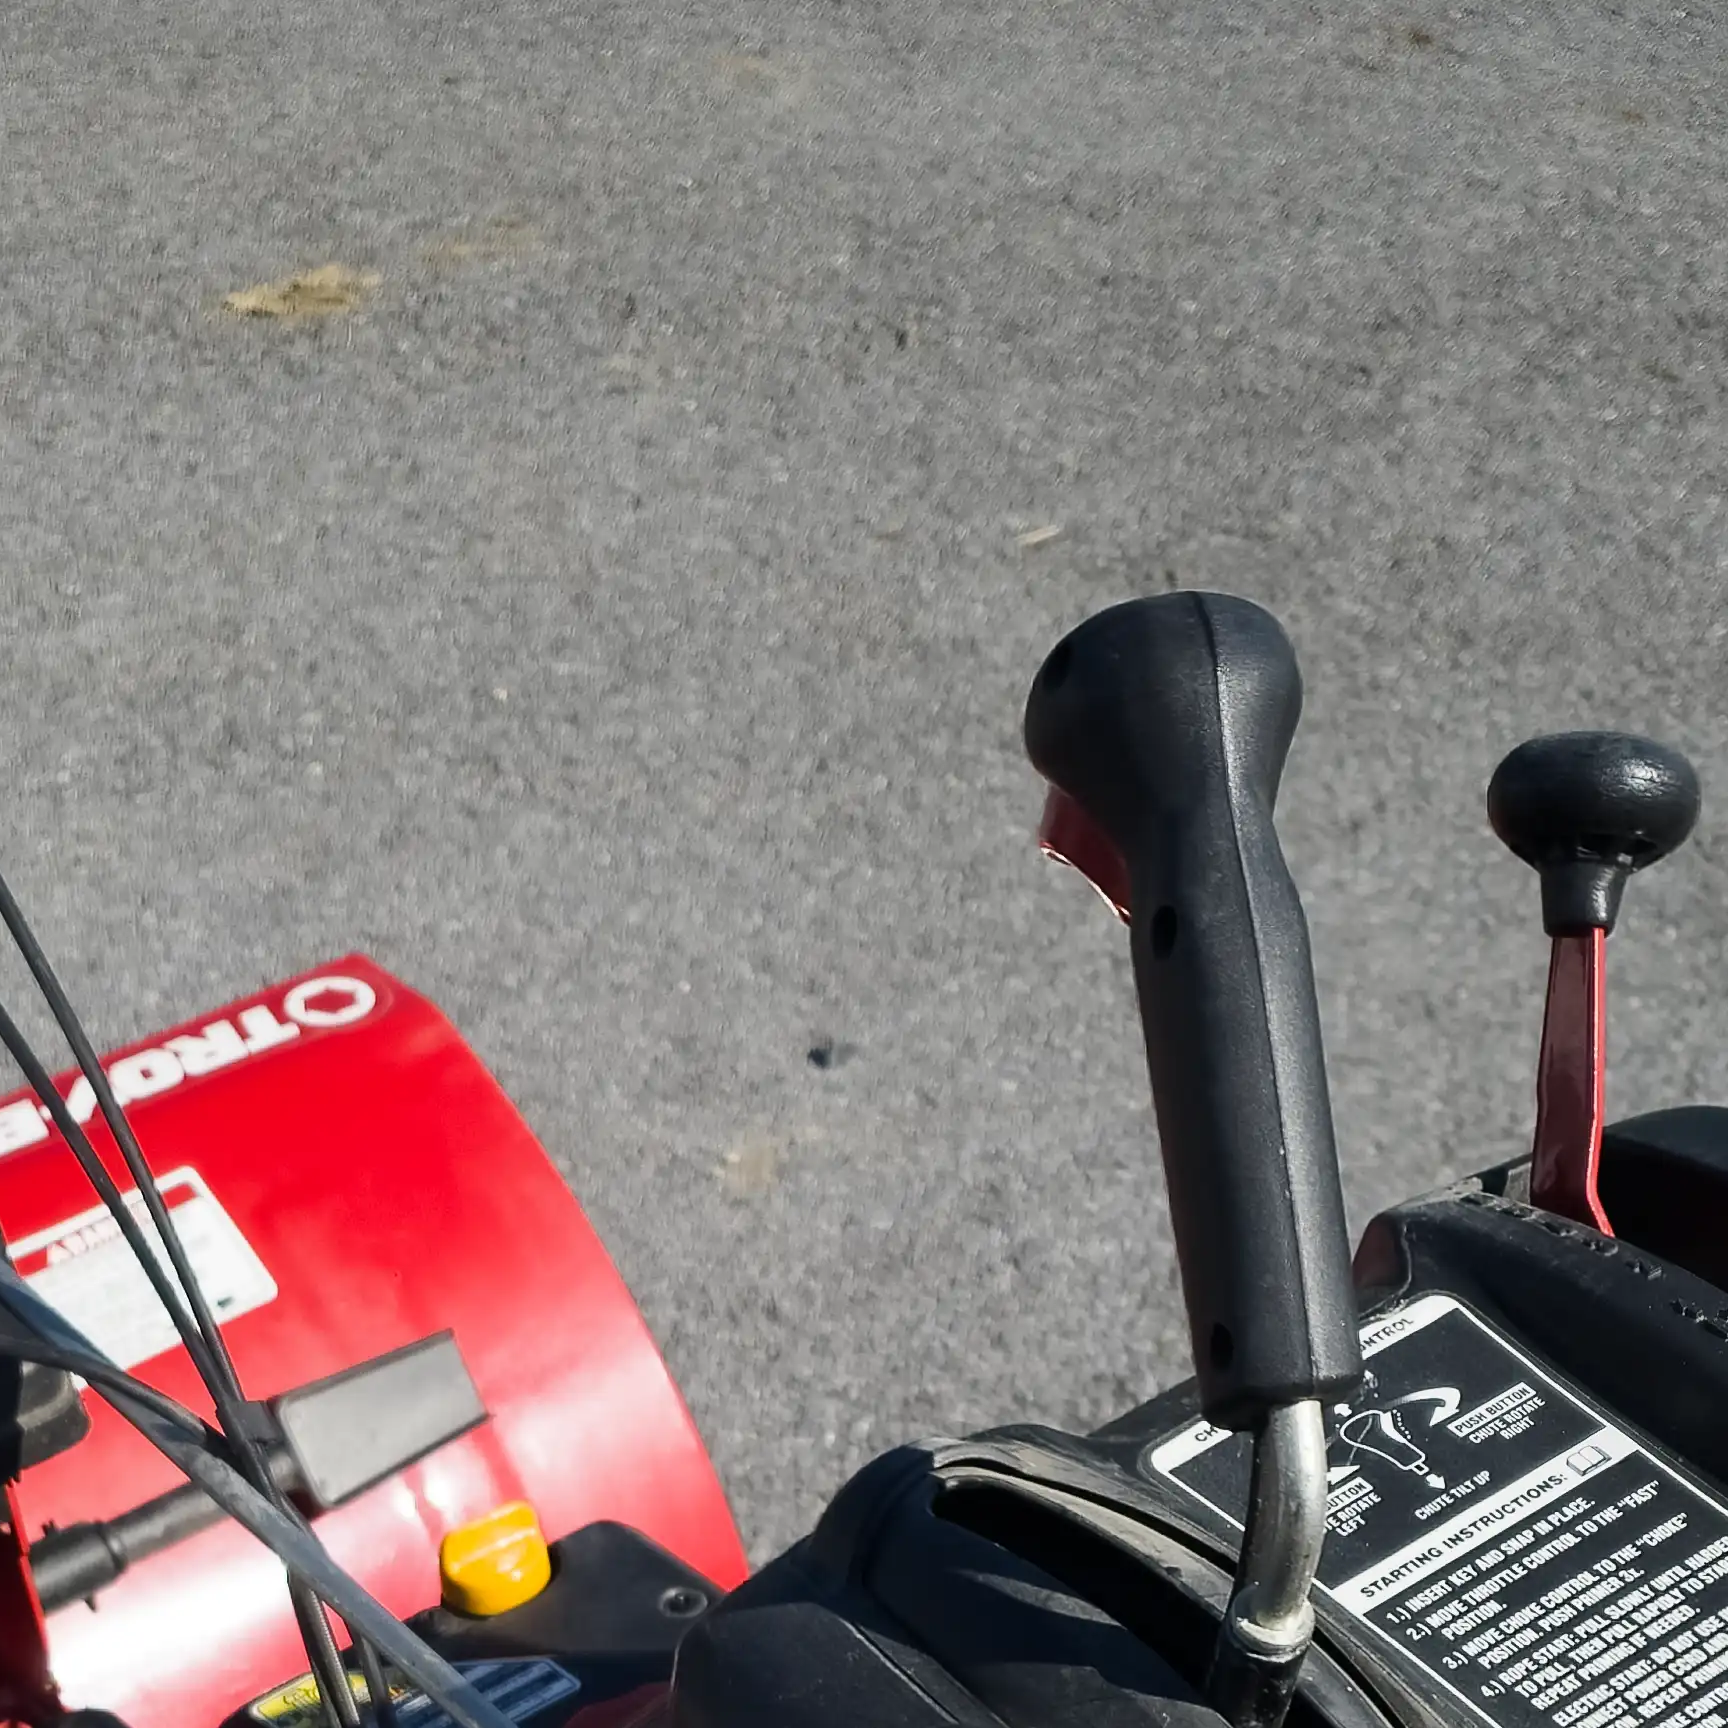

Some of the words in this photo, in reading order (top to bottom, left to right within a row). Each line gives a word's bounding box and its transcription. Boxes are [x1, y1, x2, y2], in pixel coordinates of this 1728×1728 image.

[1454, 1412, 1487, 1432] PUSH
[1485, 1387, 1530, 1415] BUTTON
[1468, 1418, 1506, 1443] CHUTE
[1502, 1396, 1545, 1423] ROTATE
[1499, 1415, 1534, 1439] RIGHT
[1319, 1481, 1368, 1511] UTTON
[1336, 1491, 1381, 1521] ROTATE
[1414, 1493, 1454, 1519] CHUTE
[1449, 1479, 1475, 1497] TILT
[1472, 1470, 1490, 1485] UP
[1335, 1514, 1365, 1536] LEFT
[1360, 1547, 1443, 1597] STARTING
[1442, 1473, 1567, 1548] INSTRUCTIONS:
[1386, 1606, 1411, 1623] 1.)
[1404, 1579, 1452, 1612] INSERT
[1447, 1563, 1477, 1586] KEY
[1475, 1549, 1505, 1571] AND
[1500, 1529, 1535, 1554] SNAP
[1532, 1519, 1553, 1535] IN
[1405, 1622, 1432, 1640] 2.)
[1424, 1599, 1468, 1628] MOVE
[1461, 1562, 1528, 1605] THROTTLE
[1522, 1532, 1582, 1569] CONTROL
[1574, 1520, 1598, 1536] TO
[1592, 1505, 1623, 1525] THE
[1441, 1599, 1507, 1640] POSITION.
[1442, 1651, 1468, 1669] 3.)
[1461, 1627, 1504, 1656] MOVE
[1498, 1602, 1546, 1633] CHOKE
[1539, 1570, 1600, 1608] CONTROL
[1592, 1558, 1616, 1575] TO
[1609, 1543, 1641, 1564] THE
[1477, 1627, 1544, 1669] POSITION.
[1537, 1603, 1577, 1631] PUSH
[1570, 1576, 1624, 1611] PRIMER
[1480, 1679, 1505, 1696] 4.)
[1498, 1657, 1538, 1685] ROPE
[1573, 1614, 1611, 1638] PULL
[1604, 1583, 1655, 1619] SLOWLY
[1649, 1565, 1691, 1590] UNTIL
[1514, 1680, 1538, 1697] TO
[1567, 1636, 1607, 1663] THEN
[1600, 1619, 1638, 1644] PULL
[1630, 1587, 1685, 1624] RAPIDLY
[1679, 1577, 1704, 1593] TO
[1530, 1673, 1582, 1710] REPEAT
[1577, 1641, 1636, 1681] PRIMING
[1628, 1632, 1647, 1648] IF
[1552, 1684, 1615, 1727] ELECTRIC
[1650, 1646, 1674, 1664] DO
[1668, 1630, 1699, 1653] NOT
[1693, 1615, 1725, 1636] USE
[1623, 1669, 1674, 1703] POWER
[1668, 1648, 1707, 1675] CORD
[1636, 1681, 1688, 1718] REPEAT
